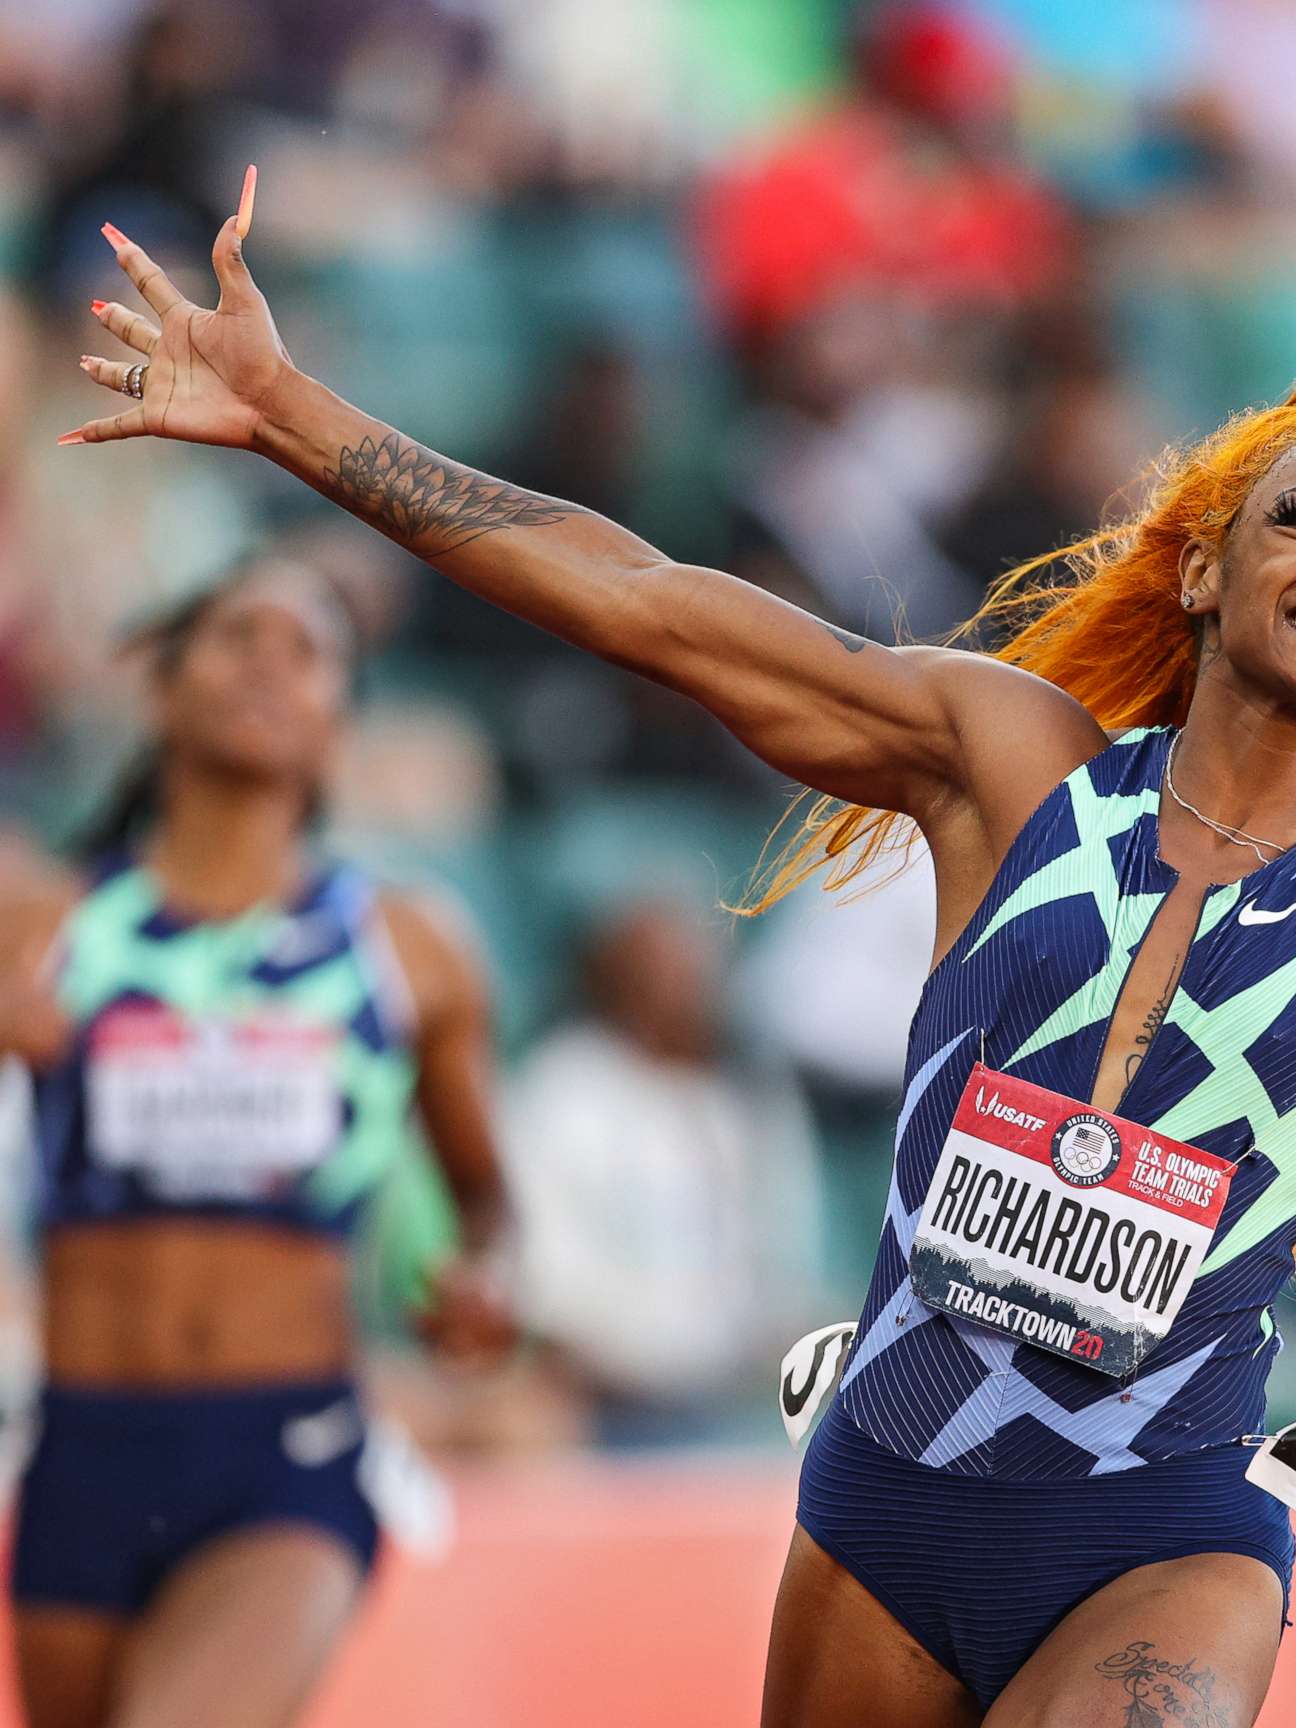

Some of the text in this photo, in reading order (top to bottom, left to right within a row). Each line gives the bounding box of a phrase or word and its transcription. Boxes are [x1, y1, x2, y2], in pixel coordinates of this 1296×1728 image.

[993, 1103, 1048, 1132] USATF
[1066, 1114, 1120, 1144] UNITED STATES
[1052, 1156, 1105, 1185] OLYMPIC TEAM
[1138, 1141, 1221, 1189] U.S. OLYMPIC
[1128, 1180, 1184, 1207] TRACK & FIELD
[1131, 1160, 1213, 1208] TEAM TRIALS
[930, 1155, 1192, 1315] RICHARDSON
